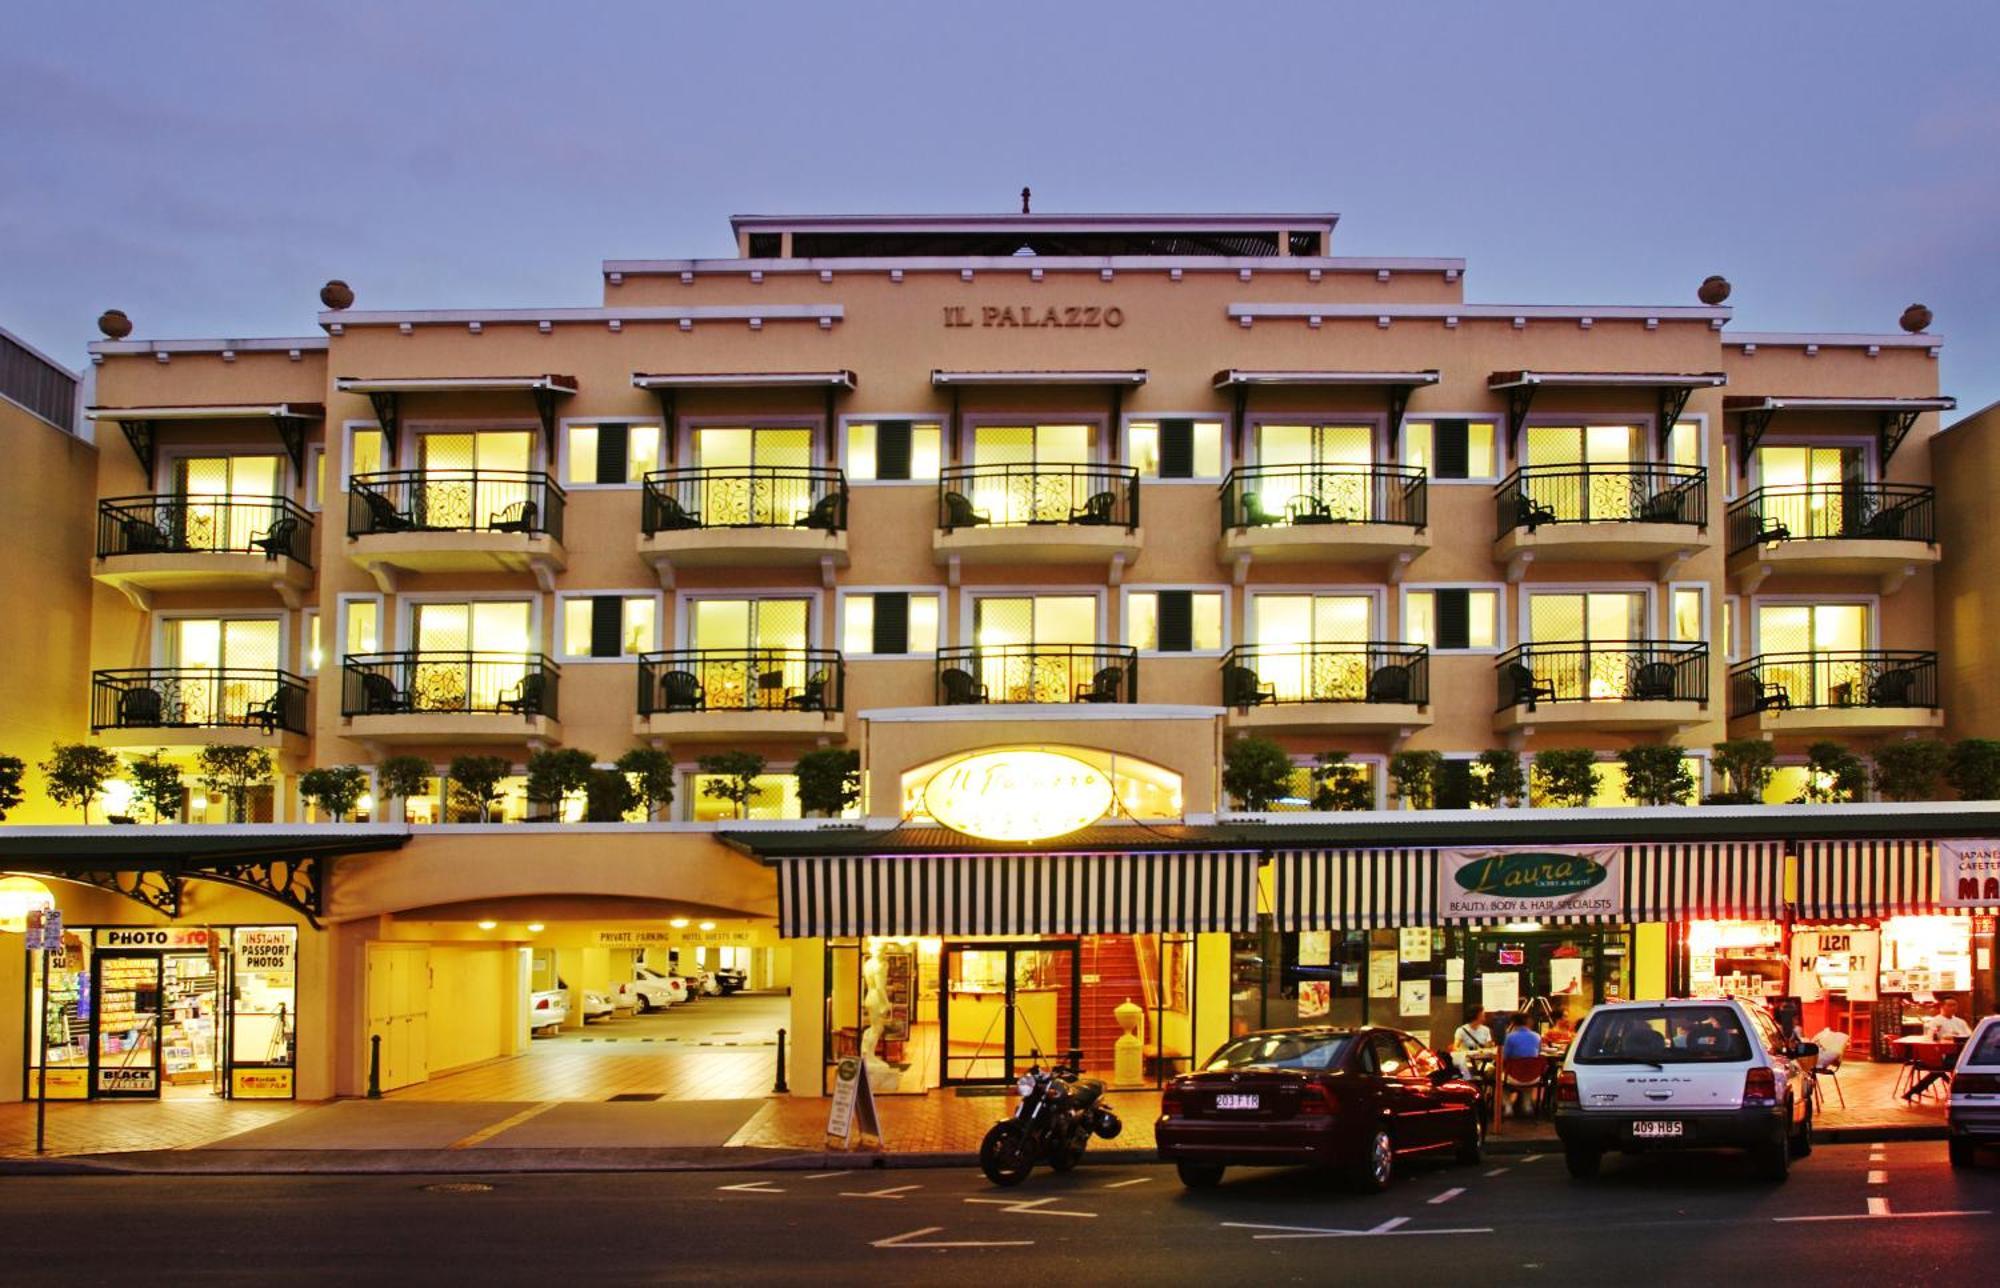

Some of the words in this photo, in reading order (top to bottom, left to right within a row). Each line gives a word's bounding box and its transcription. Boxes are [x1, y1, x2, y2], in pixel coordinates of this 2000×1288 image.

[943, 306, 973, 328] IL
[982, 306, 1125, 328] PALAZZO
[1491, 900, 1516, 911] BODY
[1519, 901, 1528, 911] &
[1531, 900, 1553, 910] HAIR
[1558, 899, 1611, 910] SPECIALISTS
[109, 931, 168, 944] PHOTO
[174, 931, 208, 944] STO
[246, 933, 285, 944] INSTANT
[600, 932, 631, 942] PRIVATE
[636, 932, 669, 941] PARKING
[242, 945, 290, 956] PASSPORT
[247, 956, 284, 967] PHOTOS
[104, 1071, 150, 1080] BLACK
[1633, 1121, 1653, 1133] 409
